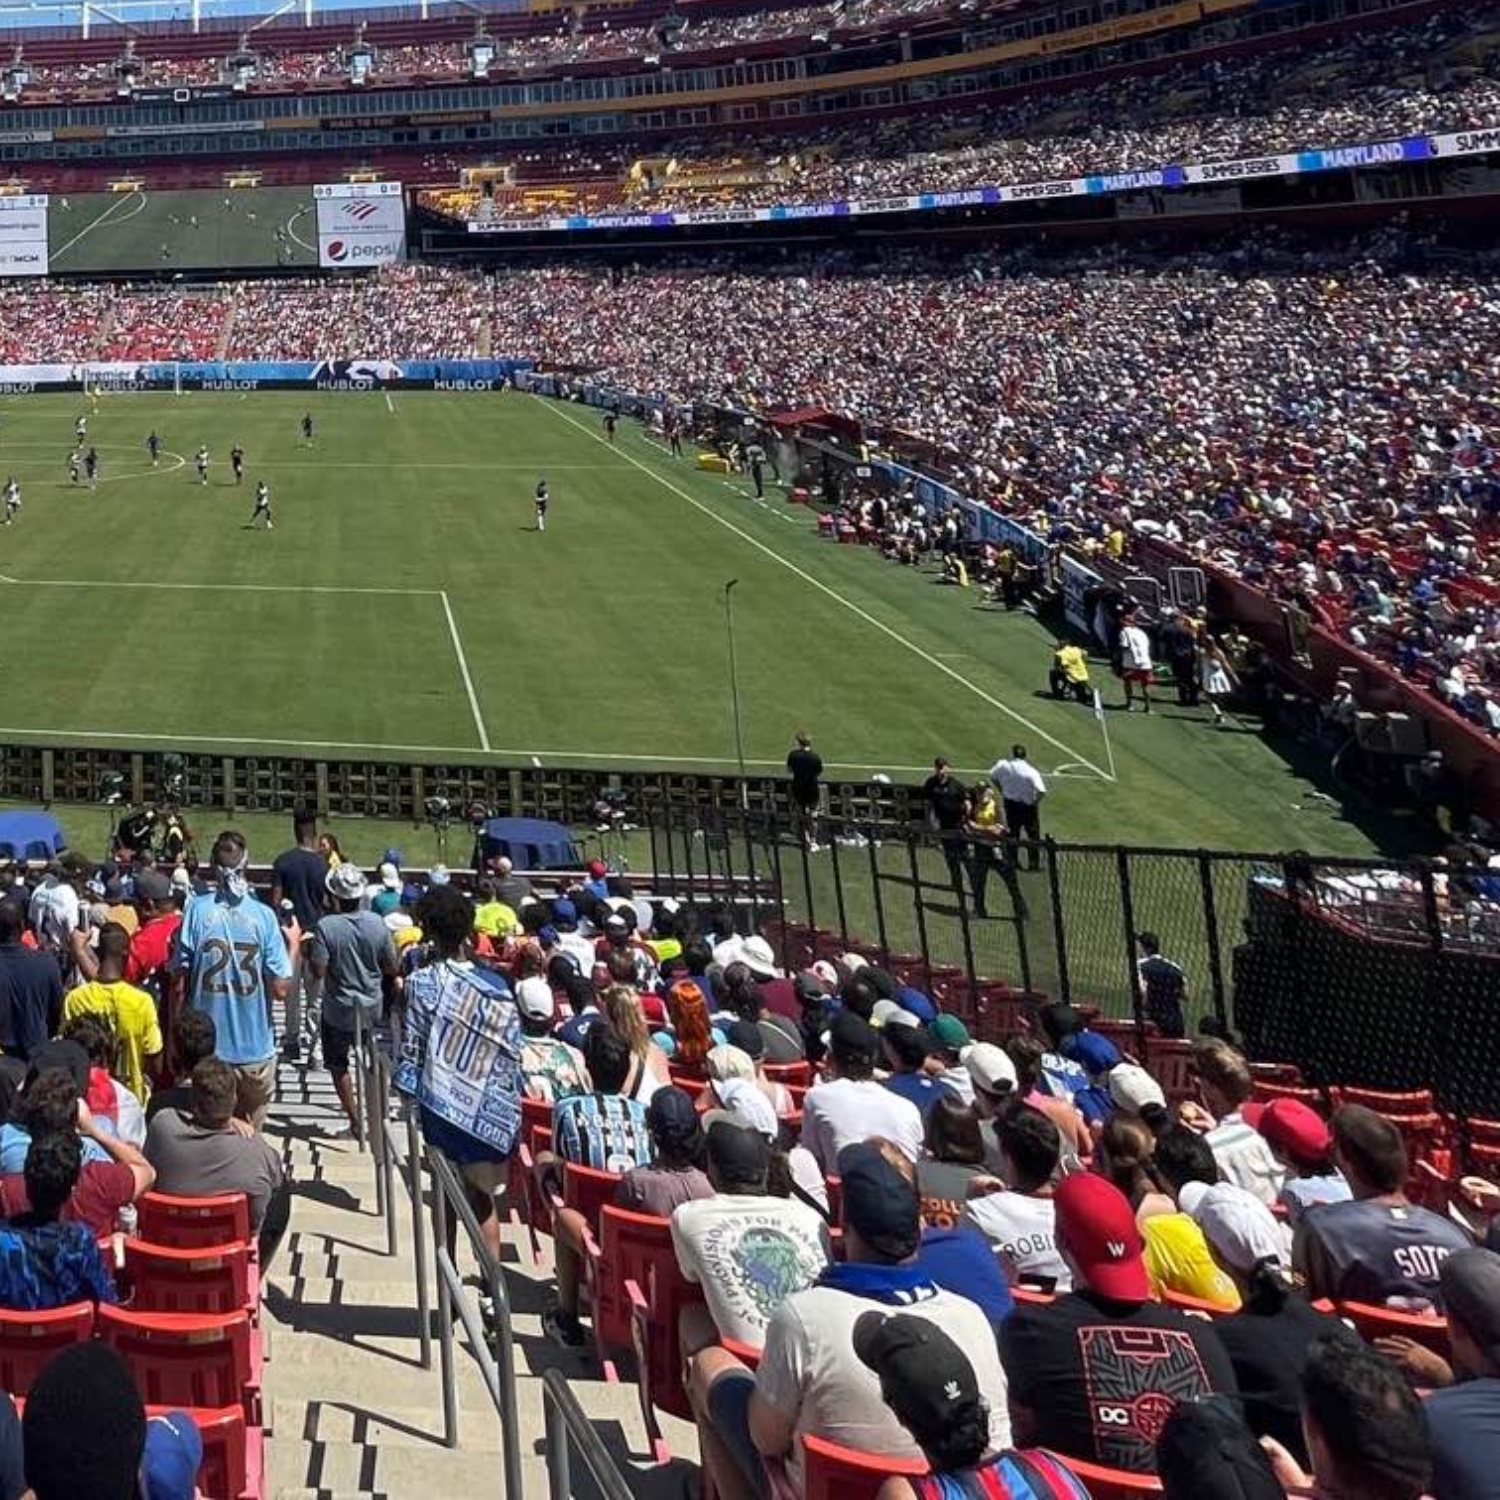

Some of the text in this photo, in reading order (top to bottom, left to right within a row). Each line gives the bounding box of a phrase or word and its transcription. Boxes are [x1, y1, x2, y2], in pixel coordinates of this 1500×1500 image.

[1322, 143, 1403, 168] MARYLAND
[1202, 158, 1280, 179] SUMMER SERIES
[1103, 171, 1163, 191] MARYLAND
[351, 241, 396, 258] pepsi
[202, 379, 258, 390] HUBLOT
[316, 379, 374, 390] HUBLOT
[434, 379, 494, 390] HUBLOT
[201, 938, 260, 997] 23
[434, 1015, 495, 1082] TOUR
[1002, 1233, 1052, 1262] ROBI
[1107, 1241, 1125, 1257] W
[1099, 1406, 1130, 1425] DC
